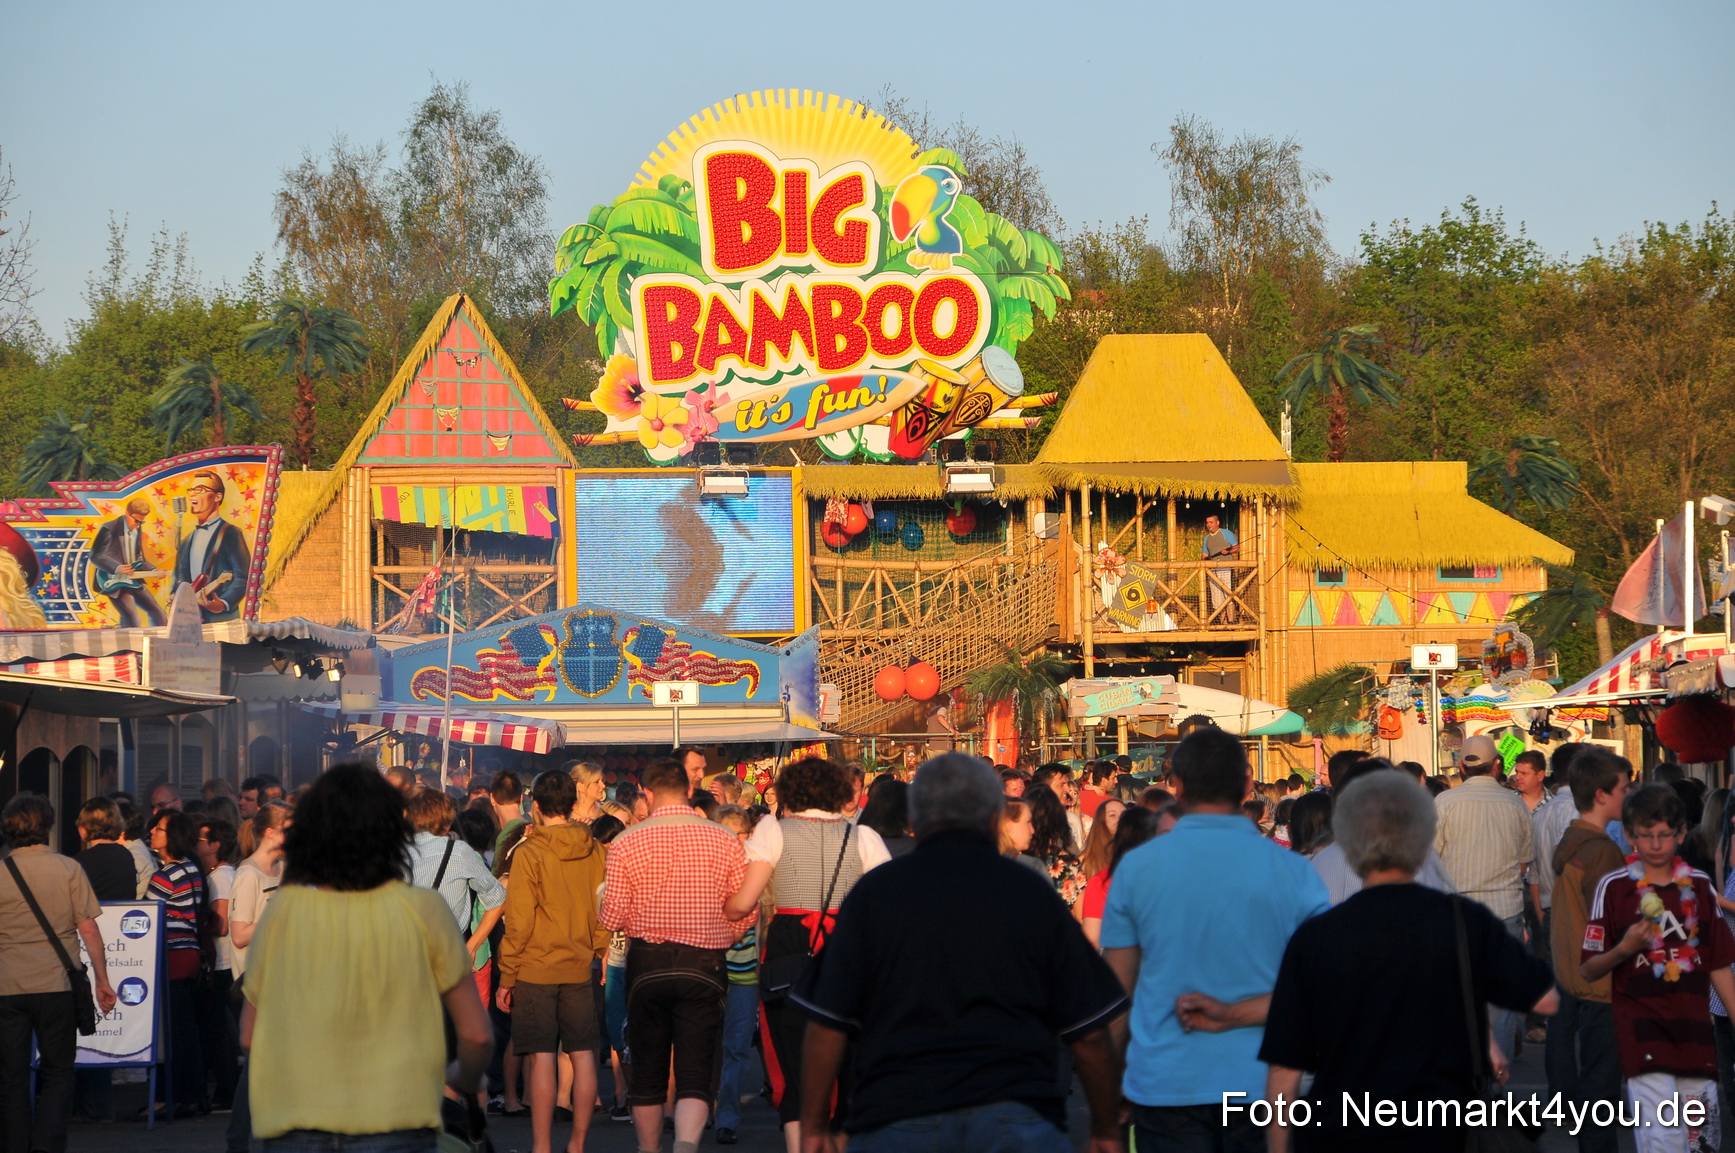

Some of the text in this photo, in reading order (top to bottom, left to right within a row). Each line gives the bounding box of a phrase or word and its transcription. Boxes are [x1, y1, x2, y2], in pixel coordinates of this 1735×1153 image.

[703, 150, 870, 273] BIG
[639, 278, 981, 384] BAMBOO
[735, 375, 888, 432] it's fun!
[1129, 564, 1157, 584] STORM
[1108, 606, 1143, 628] WARNING
[1098, 687, 1133, 702] CUBAN
[1099, 696, 1135, 711] CIGARS
